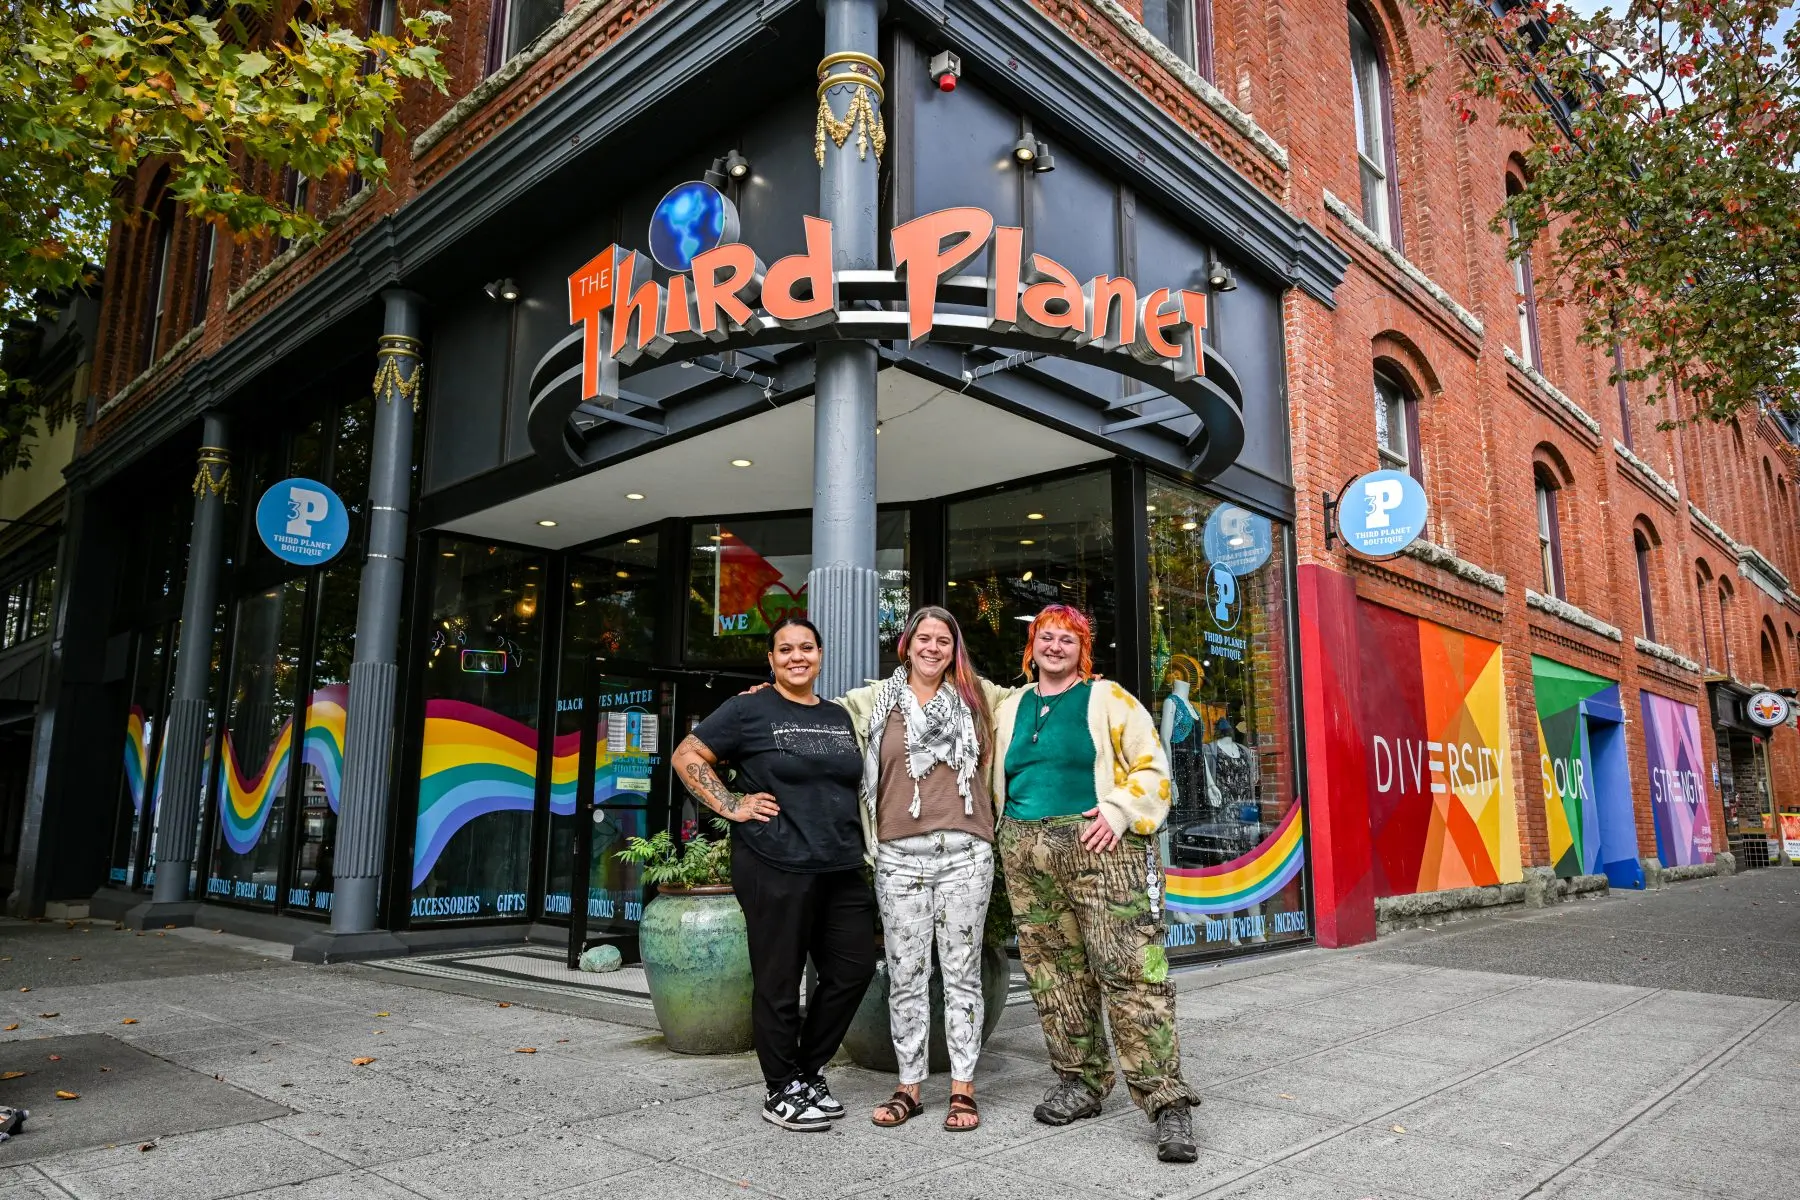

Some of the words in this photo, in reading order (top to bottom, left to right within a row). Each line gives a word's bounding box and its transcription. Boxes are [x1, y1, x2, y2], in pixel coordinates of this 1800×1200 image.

[579, 268, 610, 296] THE
[273, 534, 299, 545] THIRD
[300, 538, 332, 550] PLANET
[1355, 530, 1379, 539] THIRD
[1380, 526, 1412, 537] PLANET
[1363, 535, 1404, 546] BOUTIQUE
[281, 544, 322, 556] BOUTIQUE
[719, 613, 749, 631] WE
[1203, 630, 1223, 645] THIRD
[1224, 635, 1247, 650] PLANET
[1210, 644, 1242, 661] BOUTIQUE
[557, 697, 584, 712] BLACK
[1373, 735, 1504, 796] DIVERSITY
[1653, 766, 1705, 804] STRENGTH
[208, 877, 231, 896] CRYSTALS
[234, 880, 259, 899] JEWELRY
[289, 888, 310, 907] CANDLES
[410, 895, 480, 917] ACCESSORIES
[497, 894, 526, 912] GIFTS
[1206, 918, 1228, 943] BODY
[1230, 914, 1266, 943] JEWELRY
[1274, 911, 1305, 933] INCENSE
